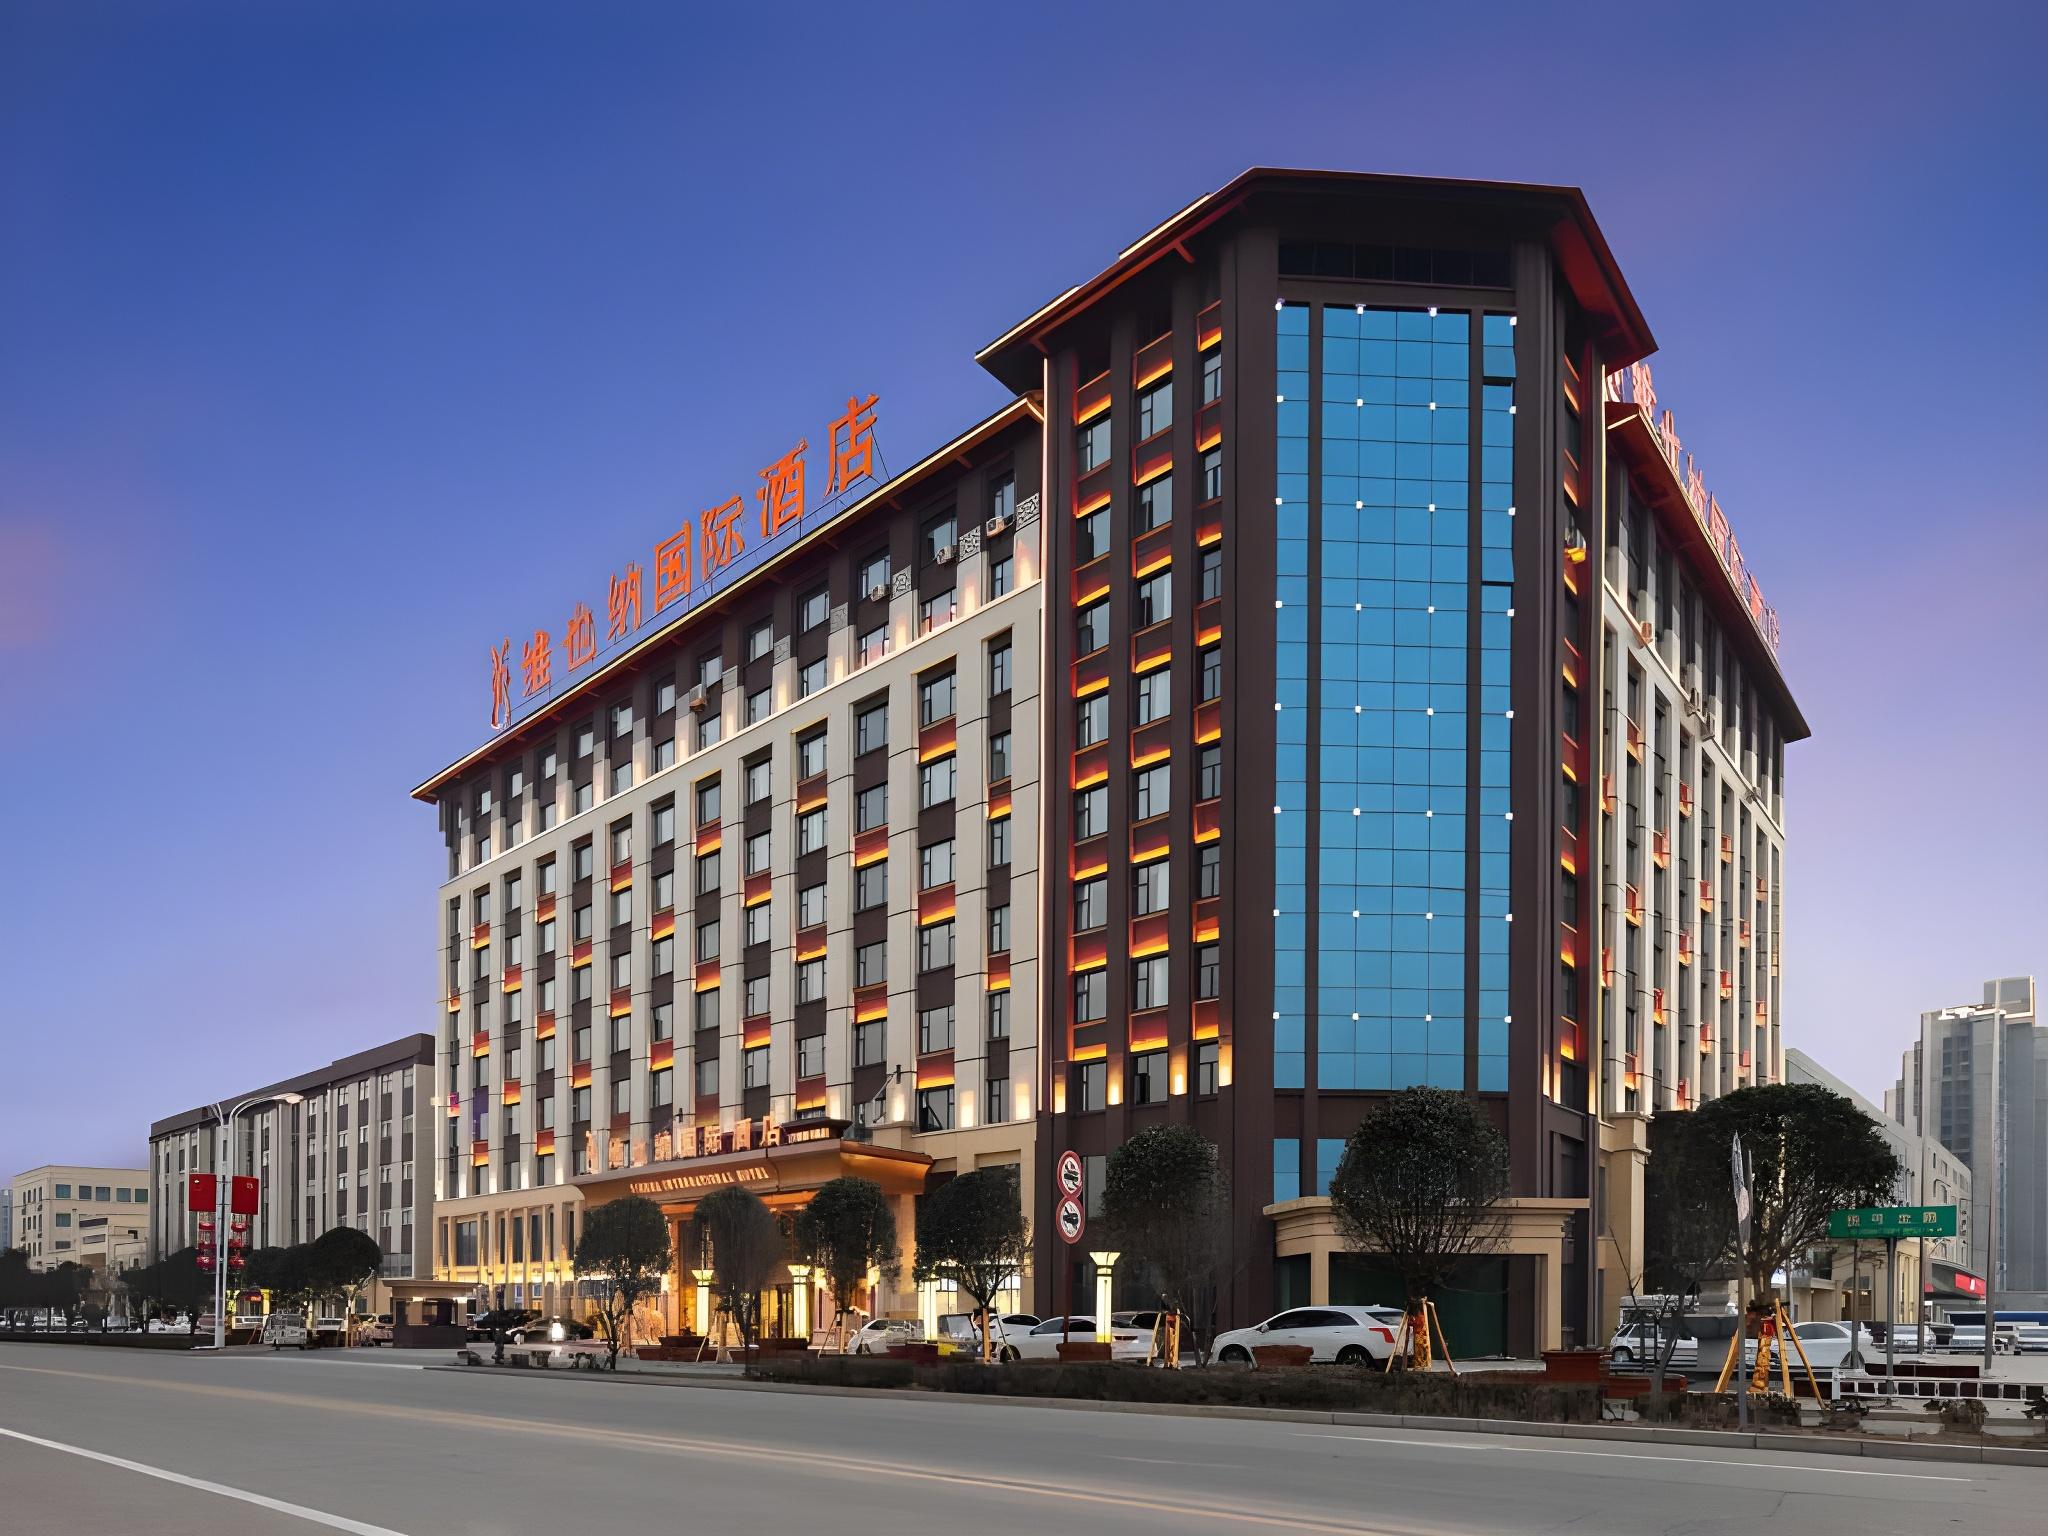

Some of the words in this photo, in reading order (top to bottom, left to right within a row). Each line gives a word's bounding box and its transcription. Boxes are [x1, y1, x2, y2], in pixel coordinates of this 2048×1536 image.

[520, 394, 880, 697] 维也纳国际酒店
